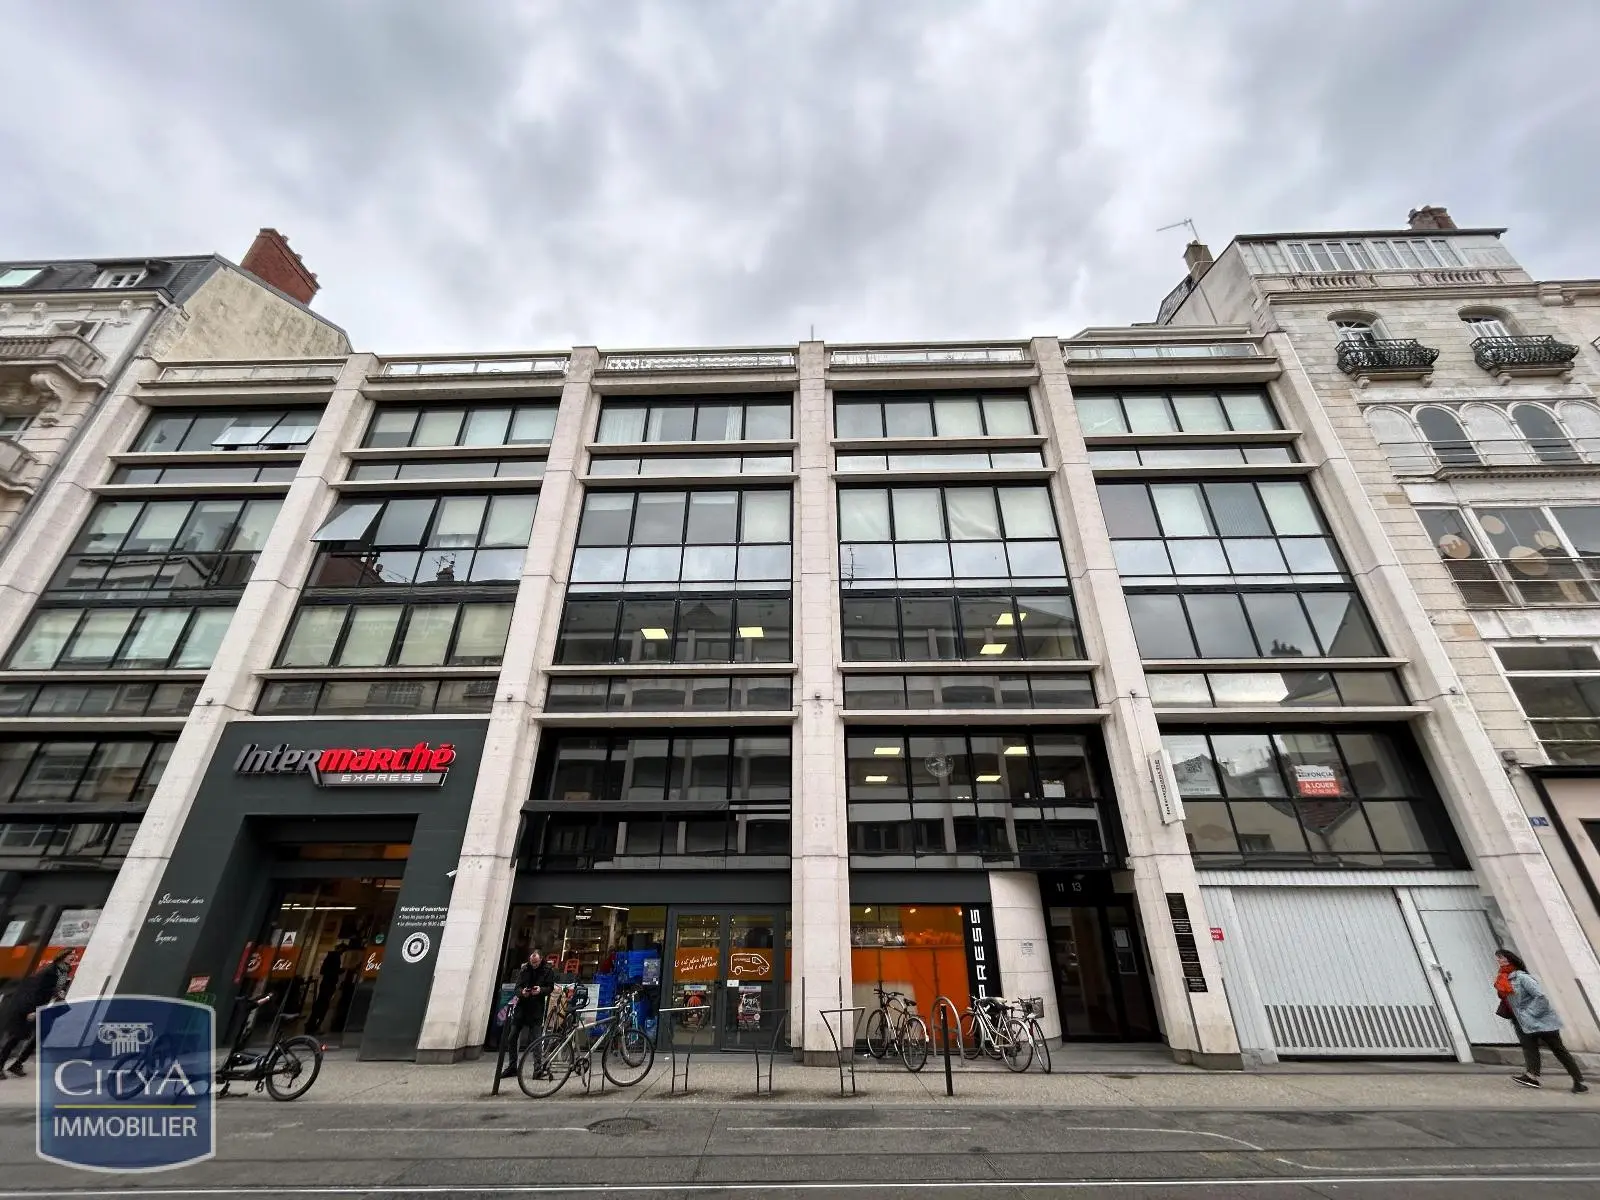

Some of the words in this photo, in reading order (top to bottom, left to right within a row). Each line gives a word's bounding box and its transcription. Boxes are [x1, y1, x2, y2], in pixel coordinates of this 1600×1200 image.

[340, 773, 423, 782] EXPRESS
[1056, 883, 1064, 892] 11
[1071, 882, 1081, 892] 13
